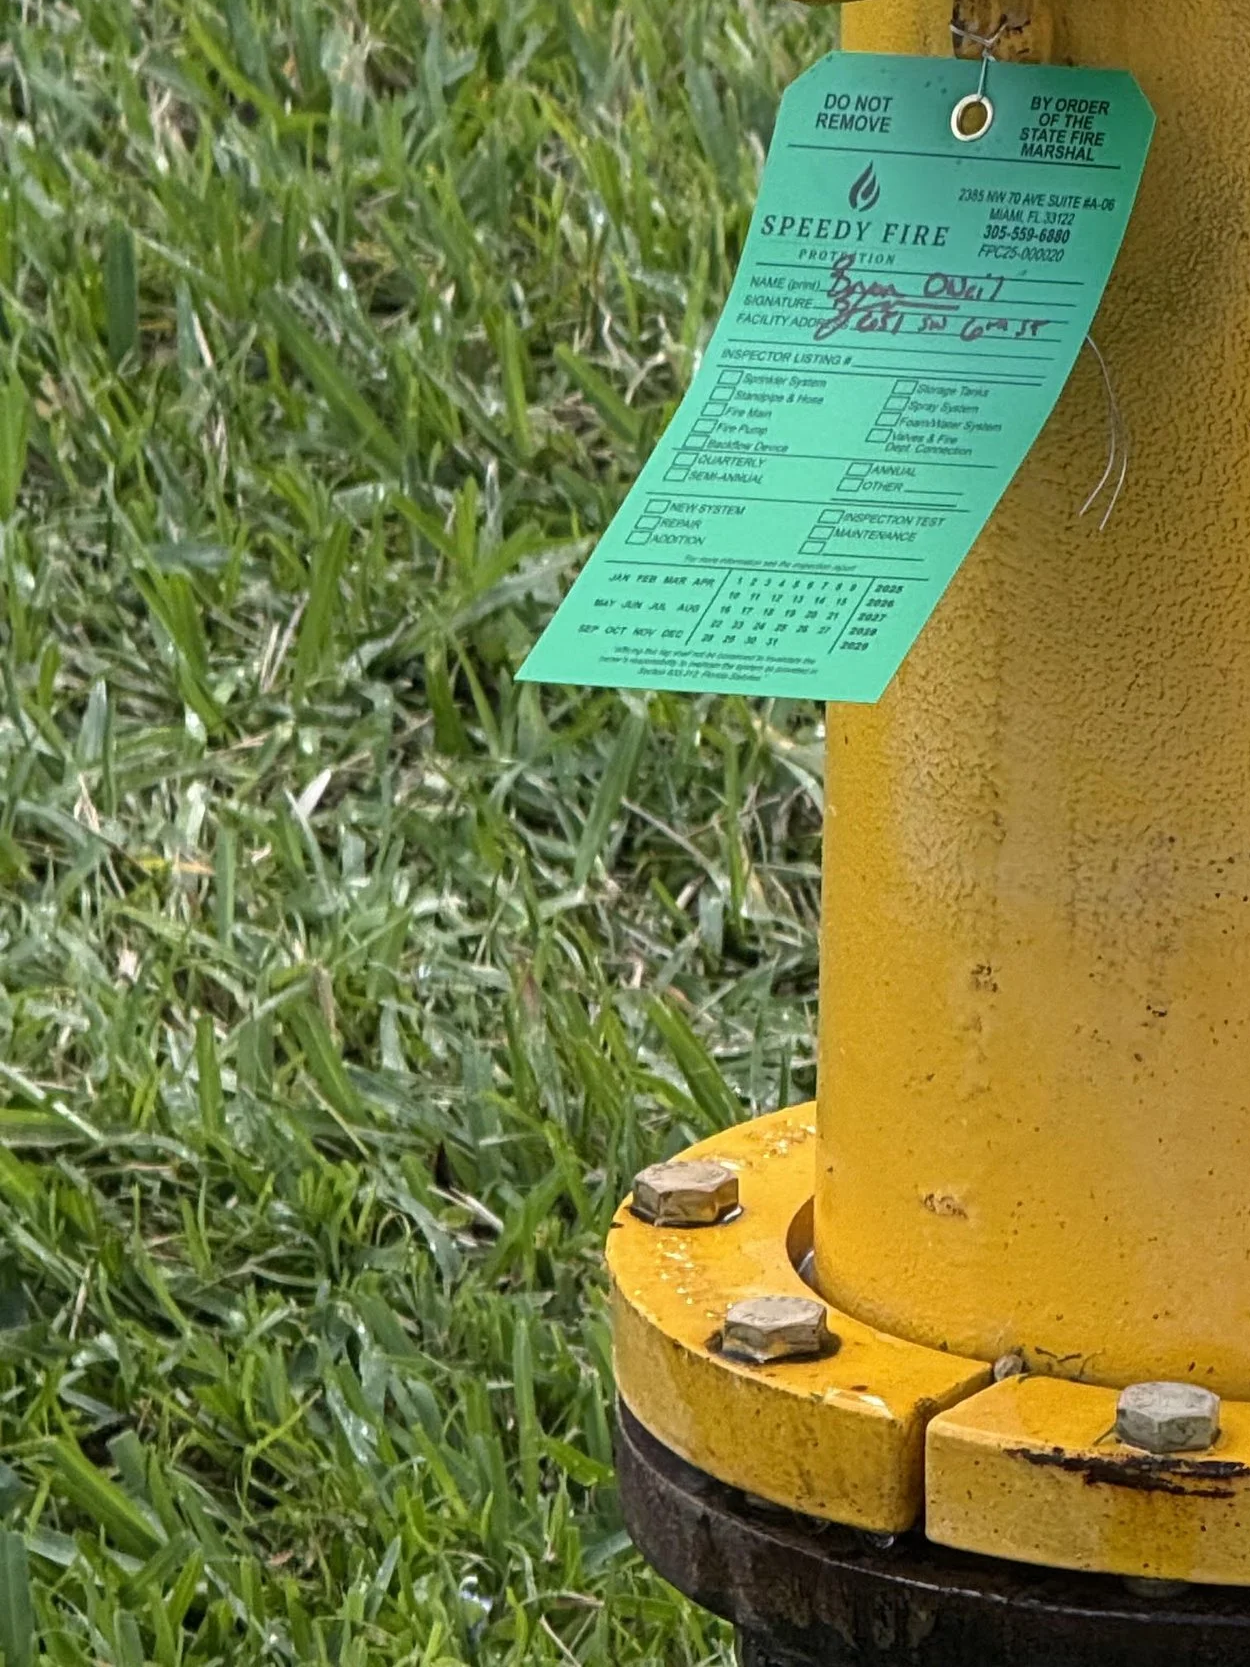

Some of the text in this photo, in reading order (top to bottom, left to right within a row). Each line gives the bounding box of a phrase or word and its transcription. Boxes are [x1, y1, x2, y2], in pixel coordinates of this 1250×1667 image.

[824, 94, 893, 112] DO NOT
[1031, 97, 1110, 115] BY ORDER
[815, 113, 892, 133] REMOVE
[1039, 113, 1094, 130] OF THE
[1020, 128, 1105, 146] STATE FIRE
[1020, 143, 1095, 162] MARSHAL
[986, 190, 1004, 203] NW
[1008, 192, 1021, 204] 70
[1022, 193, 1046, 207] AVE
[1048, 194, 1081, 209] SUITE
[1027, 211, 1040, 224] FL
[761, 214, 950, 247] SPEEDY FIRE
[983, 225, 1070, 244] 305-559-6880
[799, 248, 895, 265] PROTTION
[750, 276, 820, 291] NAME (print)
[743, 295, 814, 309] SIGNATURE
[736, 313, 789, 326] FACILITY
[721, 349, 852, 365] INSPECTOR LISTING #
[743, 374, 827, 388] Sprinkler System
[917, 384, 990, 397] Storage Tanks
[797, 394, 825, 405] Hose
[725, 407, 772, 418] Fire Main
[908, 401, 979, 414] Spray System
[715, 422, 767, 435] Fire Pump
[963, 421, 1002, 432] System
[706, 438, 789, 453] Backflow Device
[937, 434, 958, 444] Fire
[915, 444, 972, 456] Connection
[697, 454, 766, 468] QUARTERLY
[687, 471, 764, 484] SEMI-ANNUAL
[871, 464, 916, 477] ANNUAL
[862, 481, 903, 492] OTHER
[670, 502, 746, 515] NEW SYSTEM
[660, 518, 703, 529] REPAIR
[843, 513, 946, 528] INSPECTION TEST
[651, 534, 706, 546] ADDITION
[833, 528, 918, 542] MAINTENANCE
